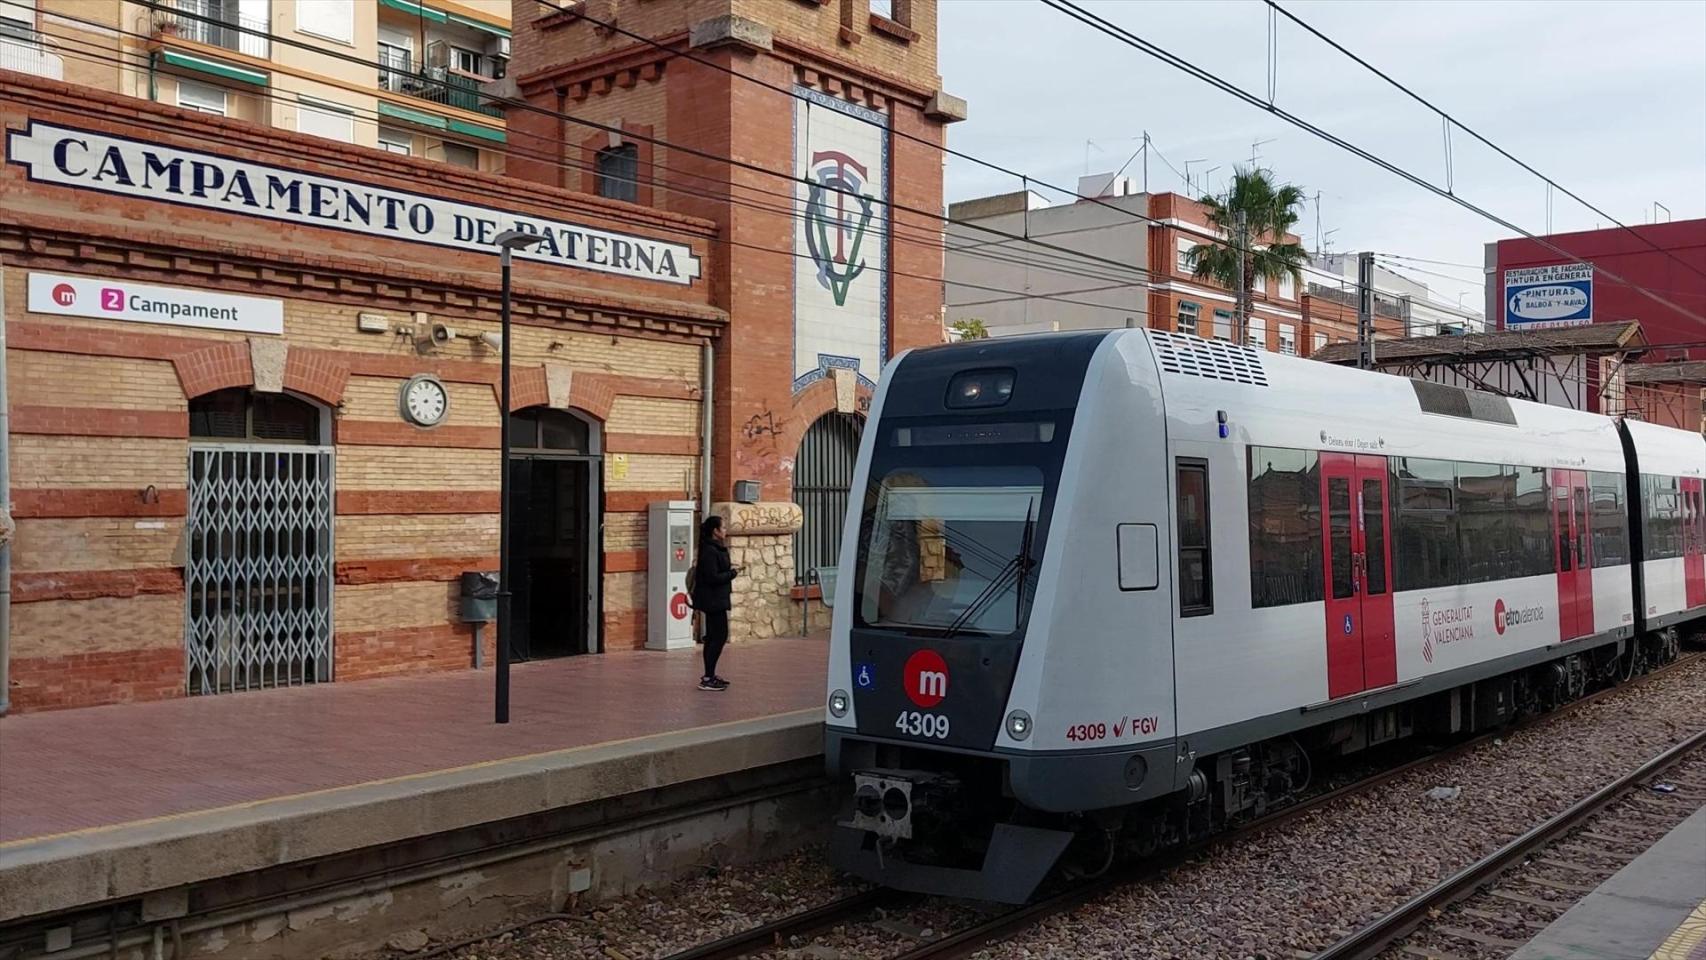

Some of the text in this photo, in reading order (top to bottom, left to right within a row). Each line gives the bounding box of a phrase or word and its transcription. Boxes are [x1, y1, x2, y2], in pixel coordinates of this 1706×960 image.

[53, 138, 680, 278] CAMPAMENTO DE PATERNA
[1506, 271, 1591, 285] PINTURA EN GENERAL
[60, 292, 76, 303] m
[1526, 288, 1575, 298] PINTURAS
[1564, 298, 1586, 306] NAVAS
[107, 292, 239, 321] 2 Campament
[1432, 606, 1473, 626] GENERALITAT
[1433, 625, 1474, 645] VALENCIANA
[919, 670, 946, 697] m
[895, 711, 950, 739] 4309
[1066, 717, 1158, 741] 4309 FGV
